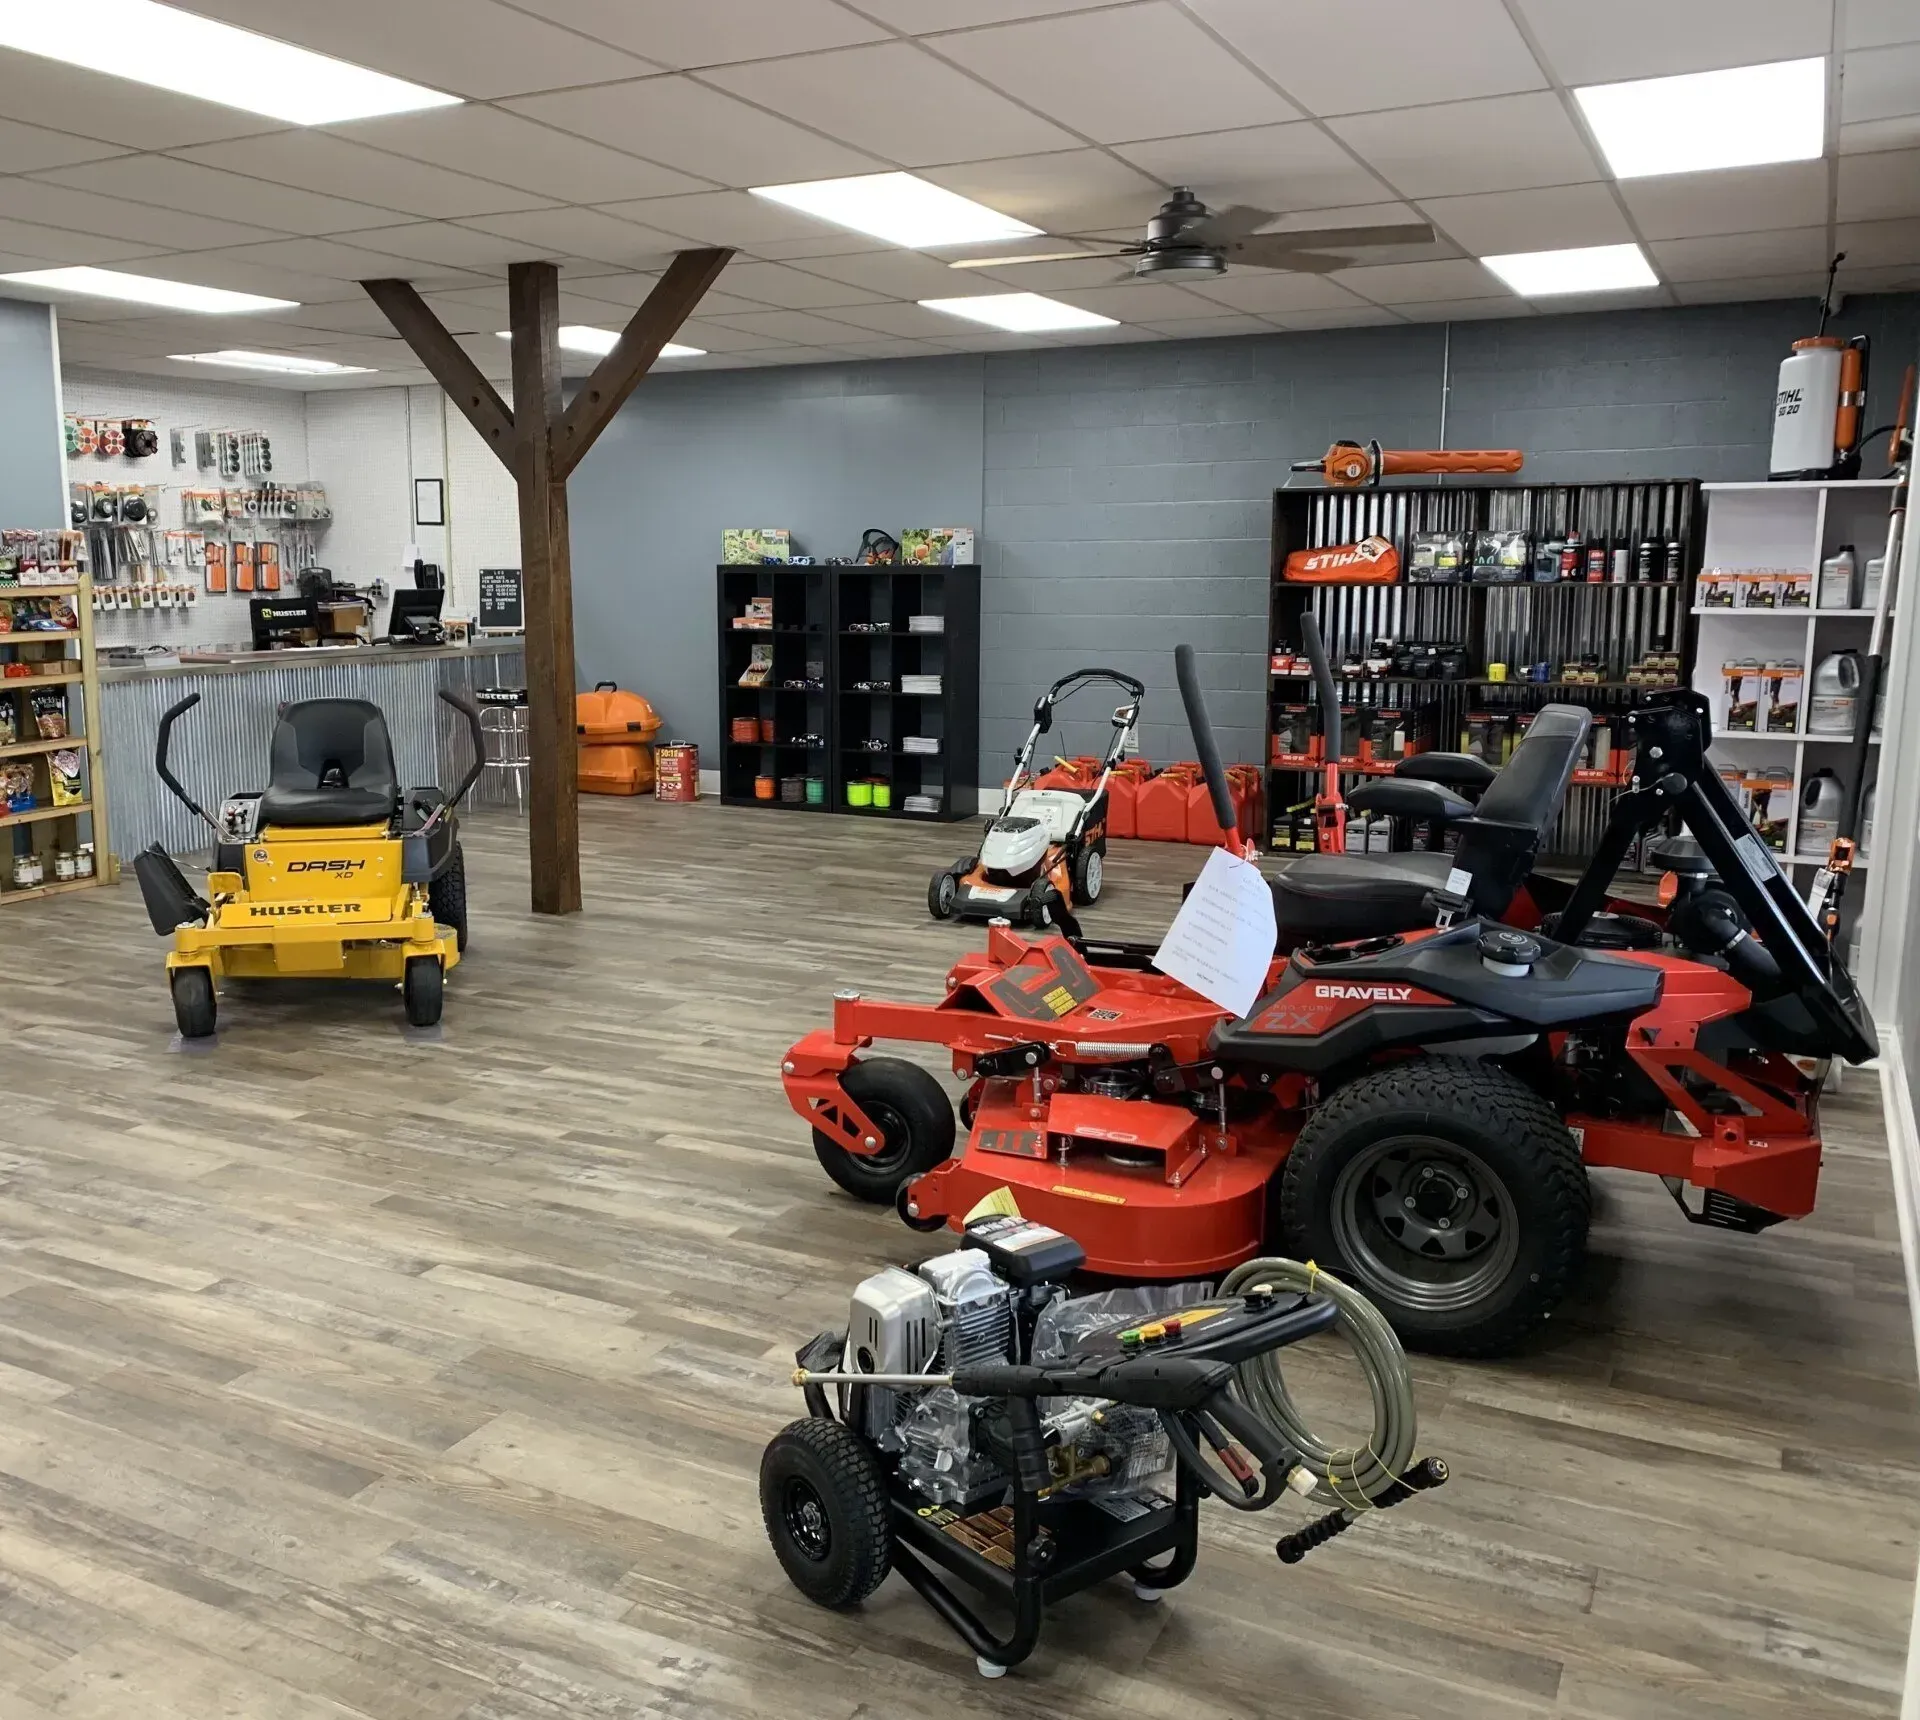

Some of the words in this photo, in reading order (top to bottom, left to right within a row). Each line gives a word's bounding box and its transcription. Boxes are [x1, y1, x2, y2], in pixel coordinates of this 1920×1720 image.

[1786, 404, 1800, 415] 20
[273, 609, 307, 617] HUSTLER
[286, 859, 366, 873] DASH
[334, 871, 354, 879] XD
[250, 903, 362, 917] HUSTLER
[1315, 985, 1413, 1001] GRAVELY
[1302, 1004, 1333, 1012] TURN
[1265, 1011, 1316, 1030] ZX
